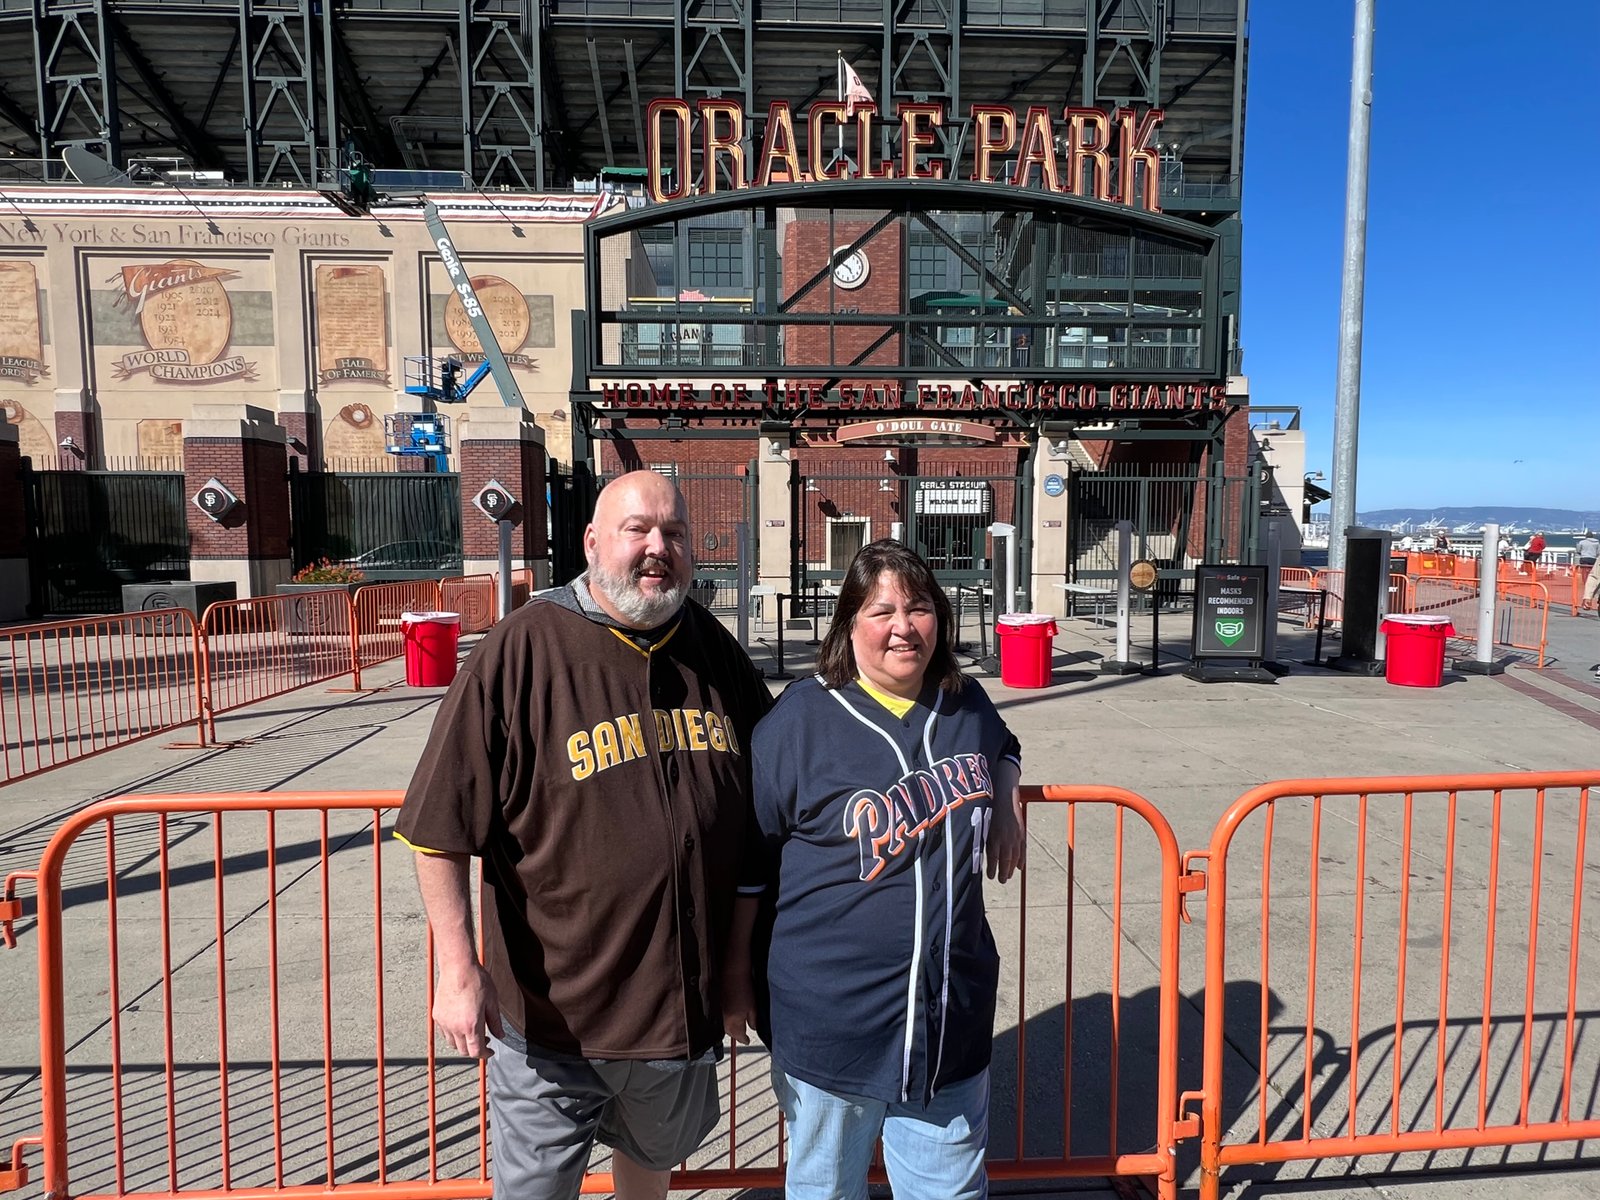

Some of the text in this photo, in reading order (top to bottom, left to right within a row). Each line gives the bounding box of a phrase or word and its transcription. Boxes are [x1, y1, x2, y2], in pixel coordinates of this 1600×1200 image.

[647, 97, 1165, 214] ORACLE PARK
[53, 223, 104, 243] York
[110, 227, 126, 243] &
[132, 223, 170, 244] San
[178, 224, 275, 245] Francisco
[282, 225, 350, 246] Giants
[437, 237, 482, 318] Genie S-85
[129, 267, 202, 315] Giants
[2, 356, 39, 370] LEAGUE
[126, 351, 187, 367] WORLD
[341, 359, 366, 368] HALL
[151, 358, 244, 379] CHAMPIONS
[326, 368, 382, 379] OF FAMERS
[601, 382, 1226, 410] HOME OF THE SAN FRANCISCO GIANTS
[876, 420, 962, 433] O'DOUL GATE
[1220, 587, 1242, 595] MASKS
[1207, 597, 1254, 605] RECOMMENDED
[1216, 607, 1244, 615] INDOORS
[566, 708, 741, 781] SAN DIEGO
[843, 753, 994, 882] PADRES
